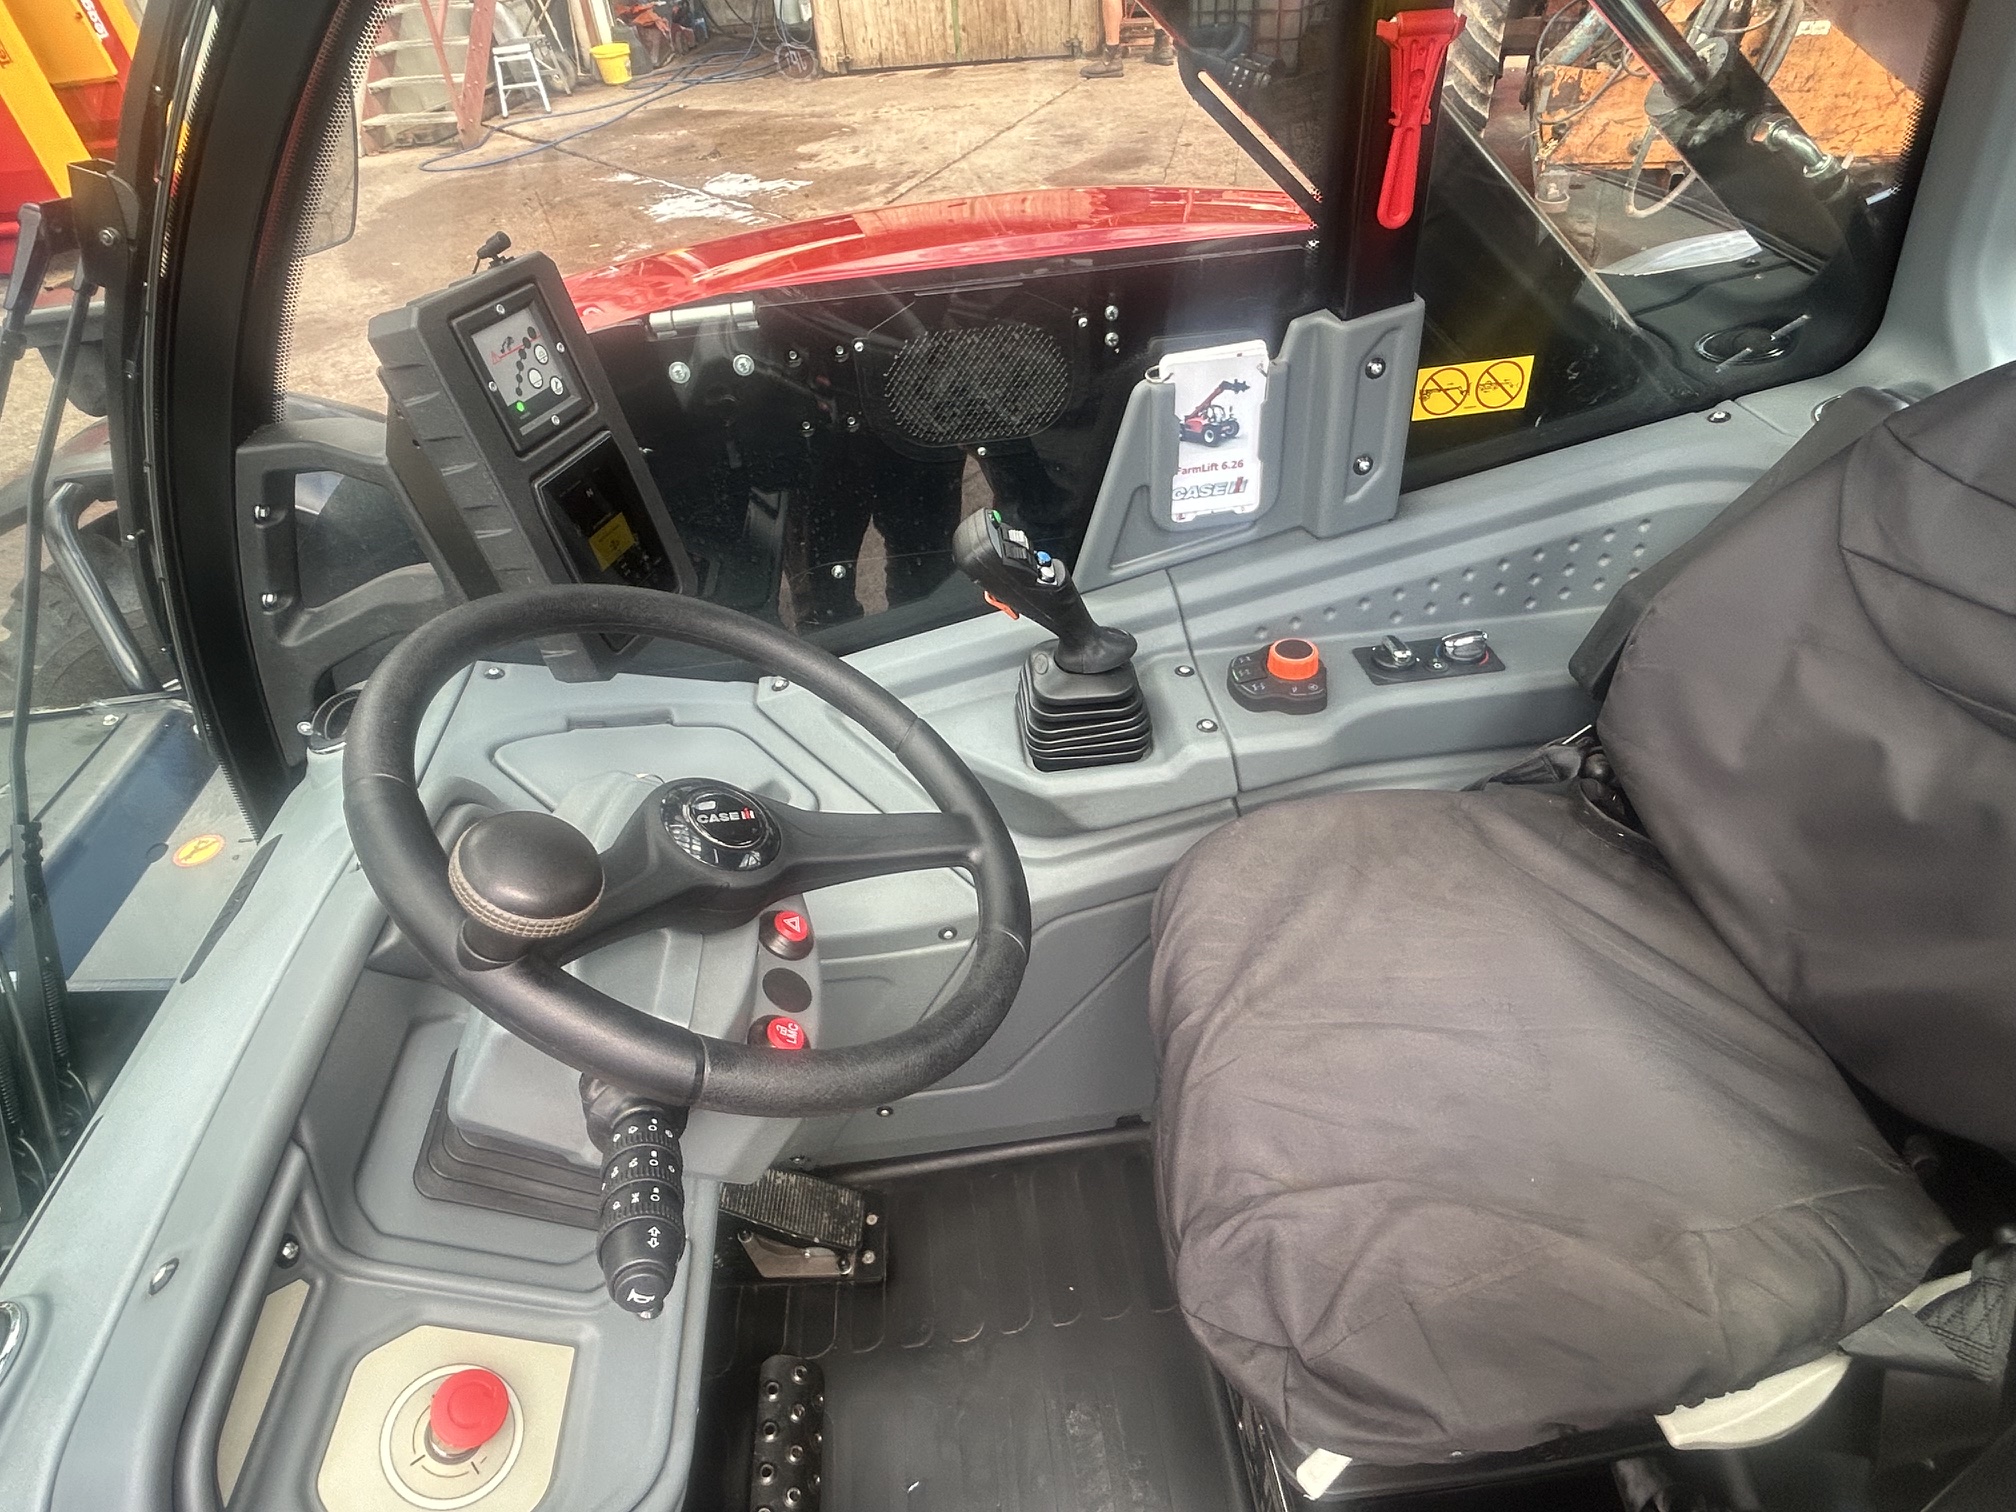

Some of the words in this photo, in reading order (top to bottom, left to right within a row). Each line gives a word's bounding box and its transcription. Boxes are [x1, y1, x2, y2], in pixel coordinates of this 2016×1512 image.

[1221, 459, 1244, 470] 6.26
[1172, 481, 1228, 501] CASE
[697, 811, 740, 824] CASE
[786, 1022, 799, 1045] LMC
